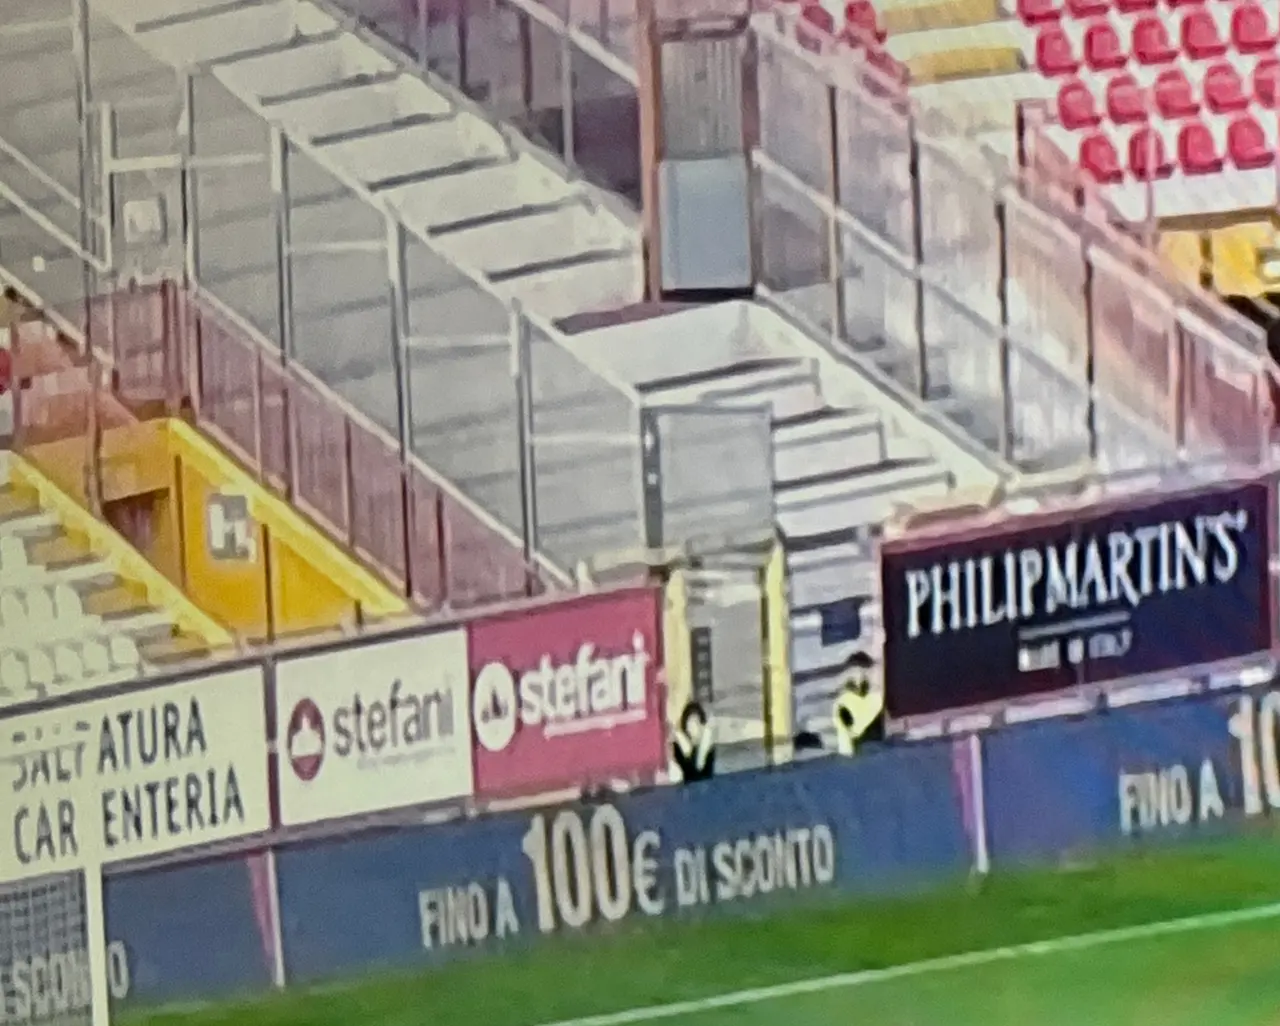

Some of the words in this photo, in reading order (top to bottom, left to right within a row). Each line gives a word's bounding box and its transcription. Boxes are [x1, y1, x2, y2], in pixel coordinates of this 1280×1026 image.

[332, 672, 455, 757] stefani
[519, 629, 650, 726] stefani
[14, 762, 246, 865] CARENTERIA
[1117, 762, 1193, 836] FINO
[1200, 757, 1225, 821] A
[418, 881, 490, 950] FINO
[497, 875, 520, 939] A
[521, 803, 666, 934] 100€
[674, 846, 711, 908] DI
[711, 823, 837, 902] SCONTO
[12, 939, 131, 1019] SCONO
